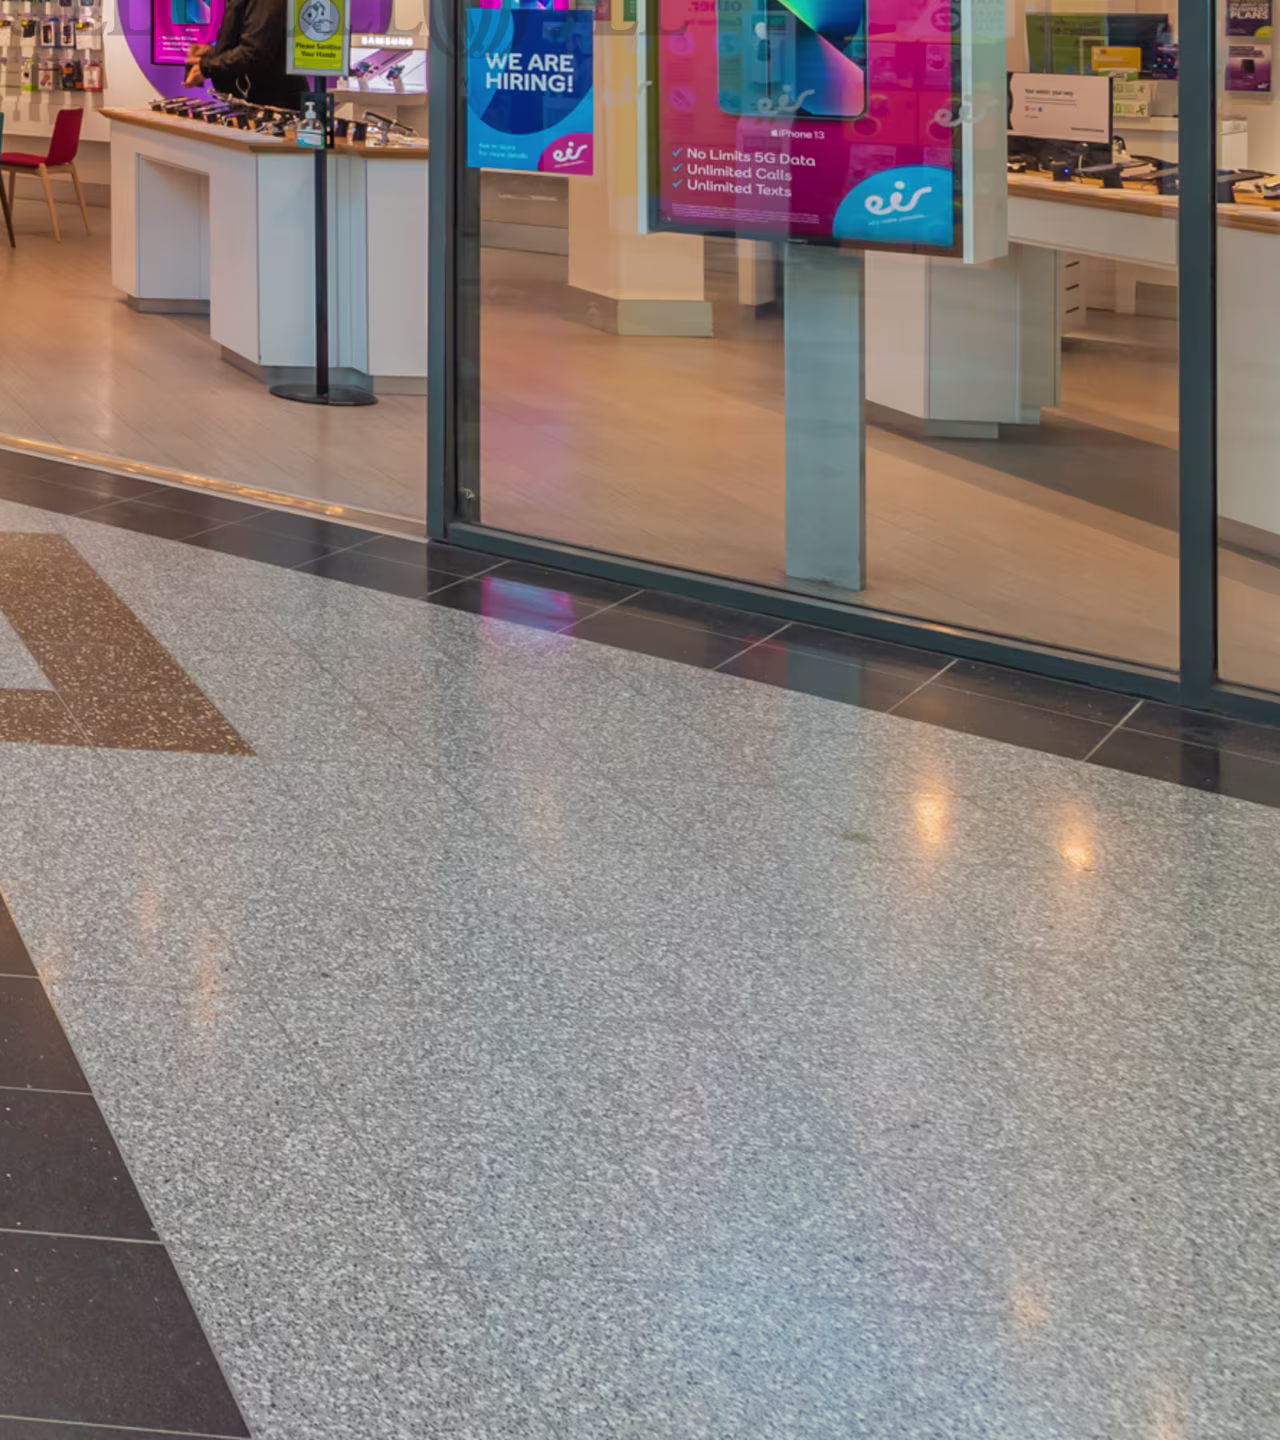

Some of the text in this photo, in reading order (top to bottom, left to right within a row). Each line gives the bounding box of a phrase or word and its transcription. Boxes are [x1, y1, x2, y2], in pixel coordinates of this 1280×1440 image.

[1230, 10, 1269, 20] PLANS
[361, 37, 414, 46] SAMSUNG
[485, 52, 574, 72] WE ARE
[485, 72, 574, 93] HIRING!
[778, 129, 825, 139] iPhone 13
[553, 141, 588, 162] eir
[687, 147, 816, 167] No Limits 5G Data
[687, 163, 792, 182] Unlimited Calls
[687, 179, 792, 198] Unlimited Texts
[865, 180, 932, 216] eir
